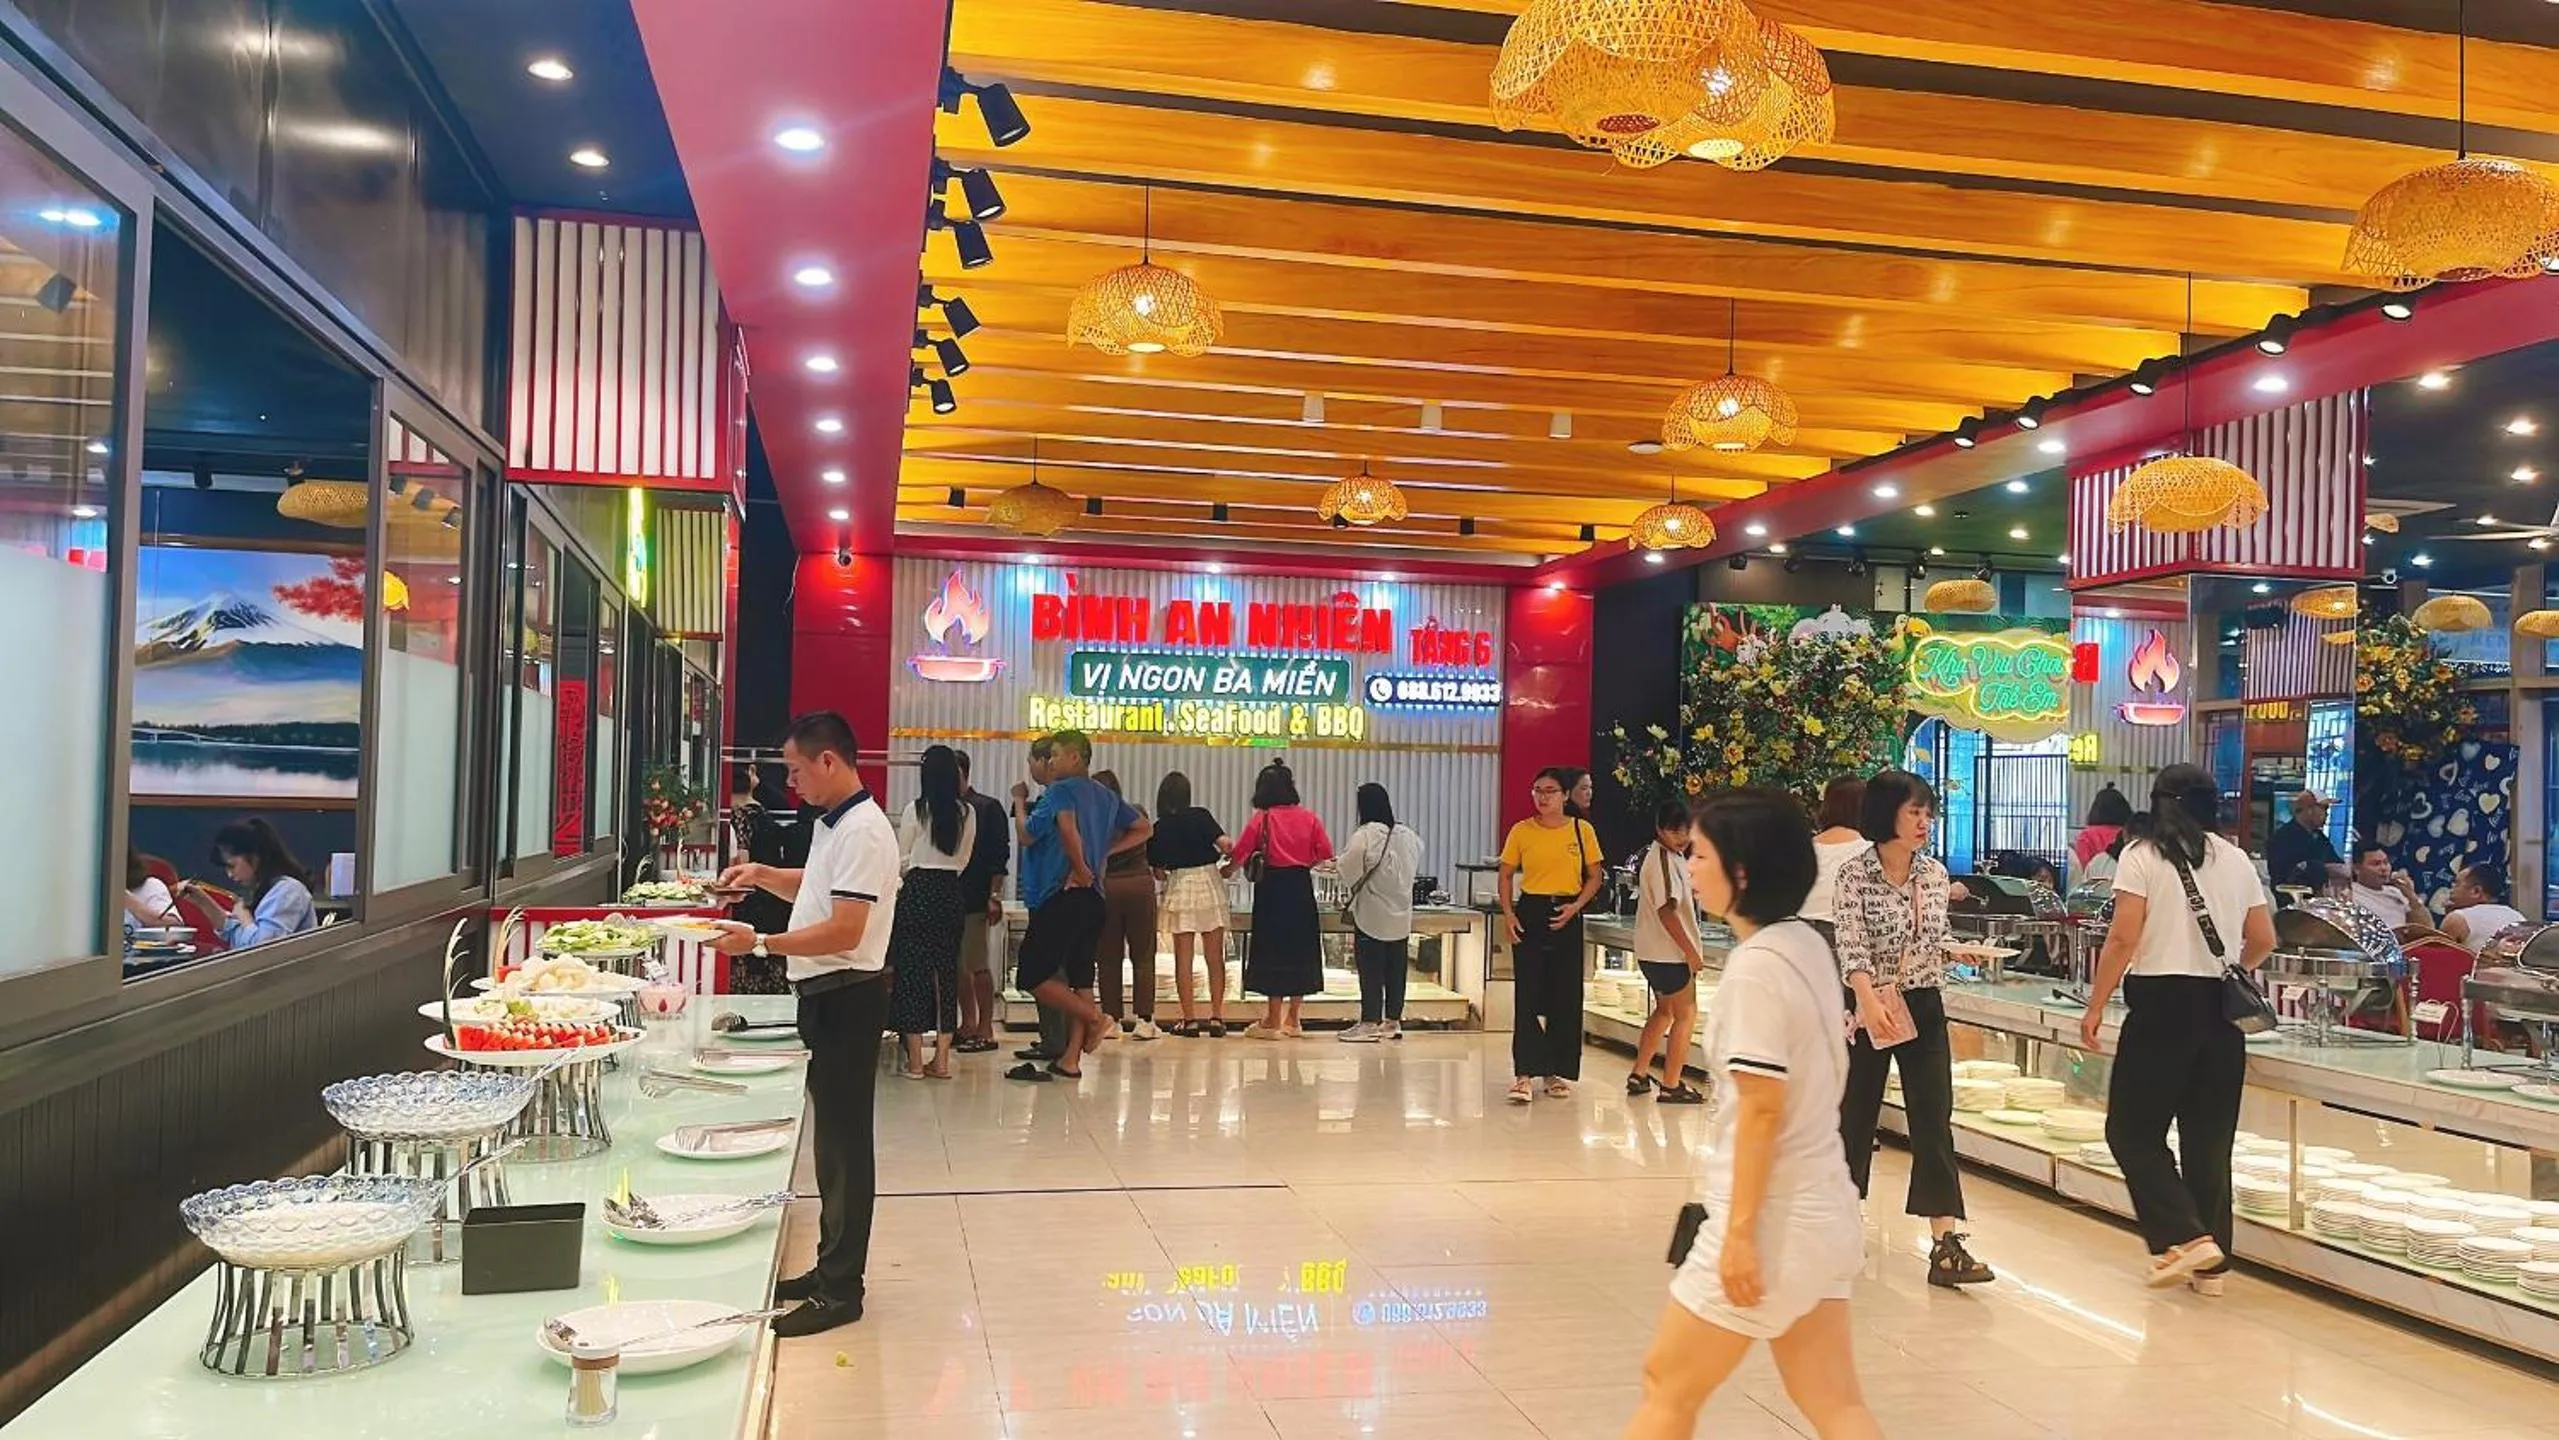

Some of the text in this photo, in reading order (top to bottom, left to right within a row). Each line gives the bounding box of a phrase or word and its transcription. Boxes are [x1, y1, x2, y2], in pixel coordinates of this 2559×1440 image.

[1032, 573, 1391, 654] BÌNH AN NHIÊN
[1473, 629, 1492, 668] 6
[1082, 662, 1112, 696] VỊ
[1118, 663, 1206, 692] NGON
[1179, 702, 1281, 735] SeaFood
[1289, 704, 1308, 736] &
[1316, 704, 1365, 741] BBQ
